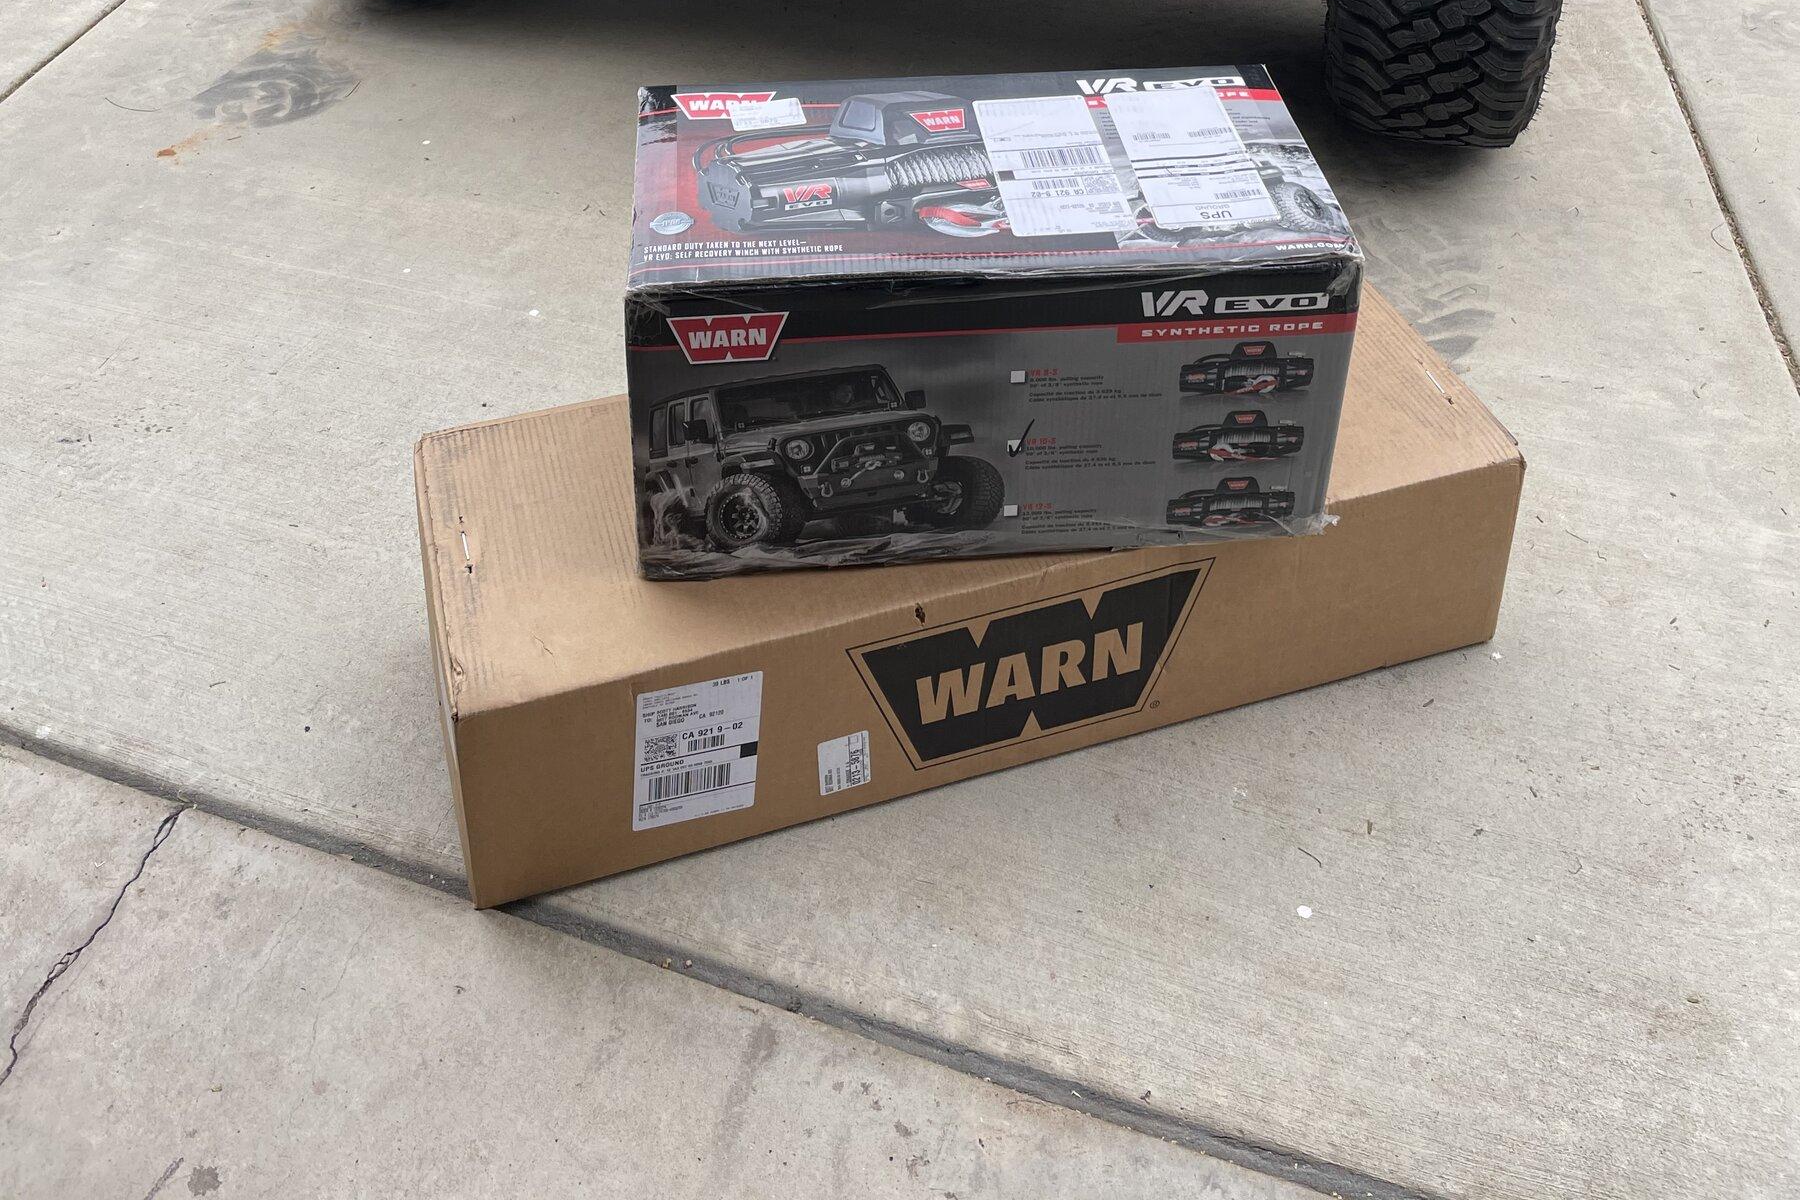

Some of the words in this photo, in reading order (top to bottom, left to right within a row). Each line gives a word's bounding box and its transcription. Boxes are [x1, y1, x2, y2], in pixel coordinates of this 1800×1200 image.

[1076, 78, 1138, 94] VR
[1147, 77, 1240, 91] EVO
[923, 115, 961, 126] WARN
[783, 183, 832, 203] VR
[786, 200, 831, 210] EVO
[1200, 211, 1233, 220] UPS
[643, 242, 682, 254] STANDARD
[684, 241, 704, 250] DUTY
[706, 240, 729, 249] TAKEN
[731, 240, 740, 249] TO
[742, 240, 756, 248] THE
[758, 239, 776, 248] NEXT
[643, 253, 653, 262] VR
[655, 252, 673, 261] EVO:
[675, 250, 693, 259] SELF
[694, 248, 732, 258] RECOVERY
[734, 247, 759, 256] WINCH
[761, 247, 780, 255] WITH
[782, 245, 822, 255] SYNTHETIC
[824, 244, 843, 252] ROPE
[1275, 242, 1345, 251] WARN.COM
[1141, 289, 1209, 318] VR
[1220, 294, 1323, 312] EVO
[1141, 324, 1260, 338] SYNTHETIC
[1269, 321, 1323, 332] ROPE
[688, 328, 767, 349] WARN
[915, 622, 1144, 725] WARN
[656, 720, 668, 728] SAN
[668, 717, 685, 725] DIEGO
[682, 731, 695, 740] CA
[697, 727, 714, 737] 921
[640, 765, 654, 773] UPS
[655, 759, 684, 770] GROUND
